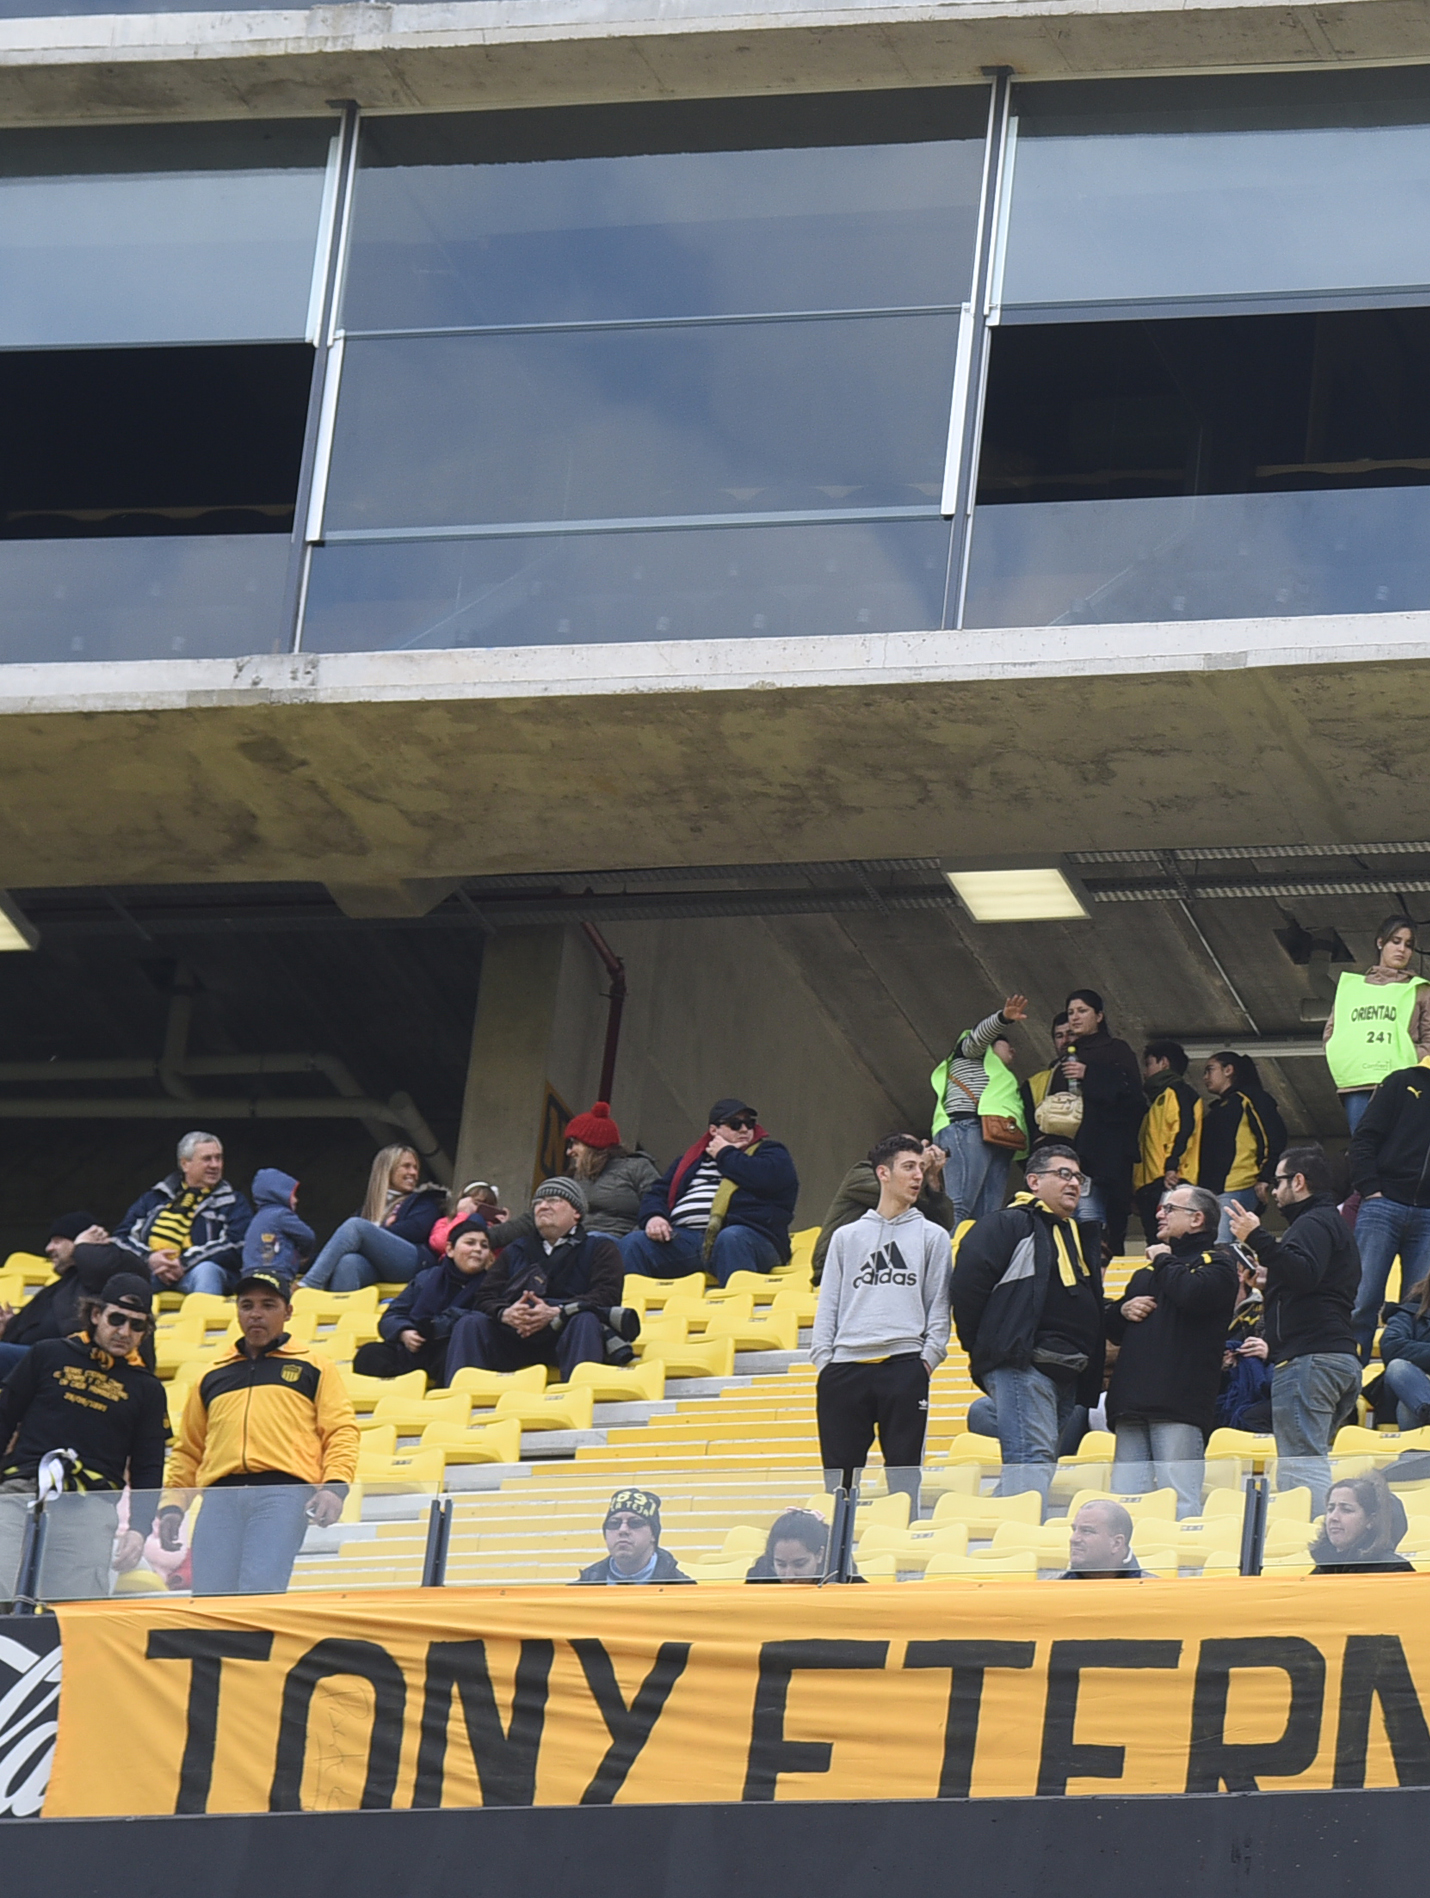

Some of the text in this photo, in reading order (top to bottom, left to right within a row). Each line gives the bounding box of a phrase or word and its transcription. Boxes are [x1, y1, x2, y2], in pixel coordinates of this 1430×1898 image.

[1366, 1031, 1392, 1044] 241
[853, 1267, 917, 1289] adidas
[145, 1628, 691, 1814] TONY
